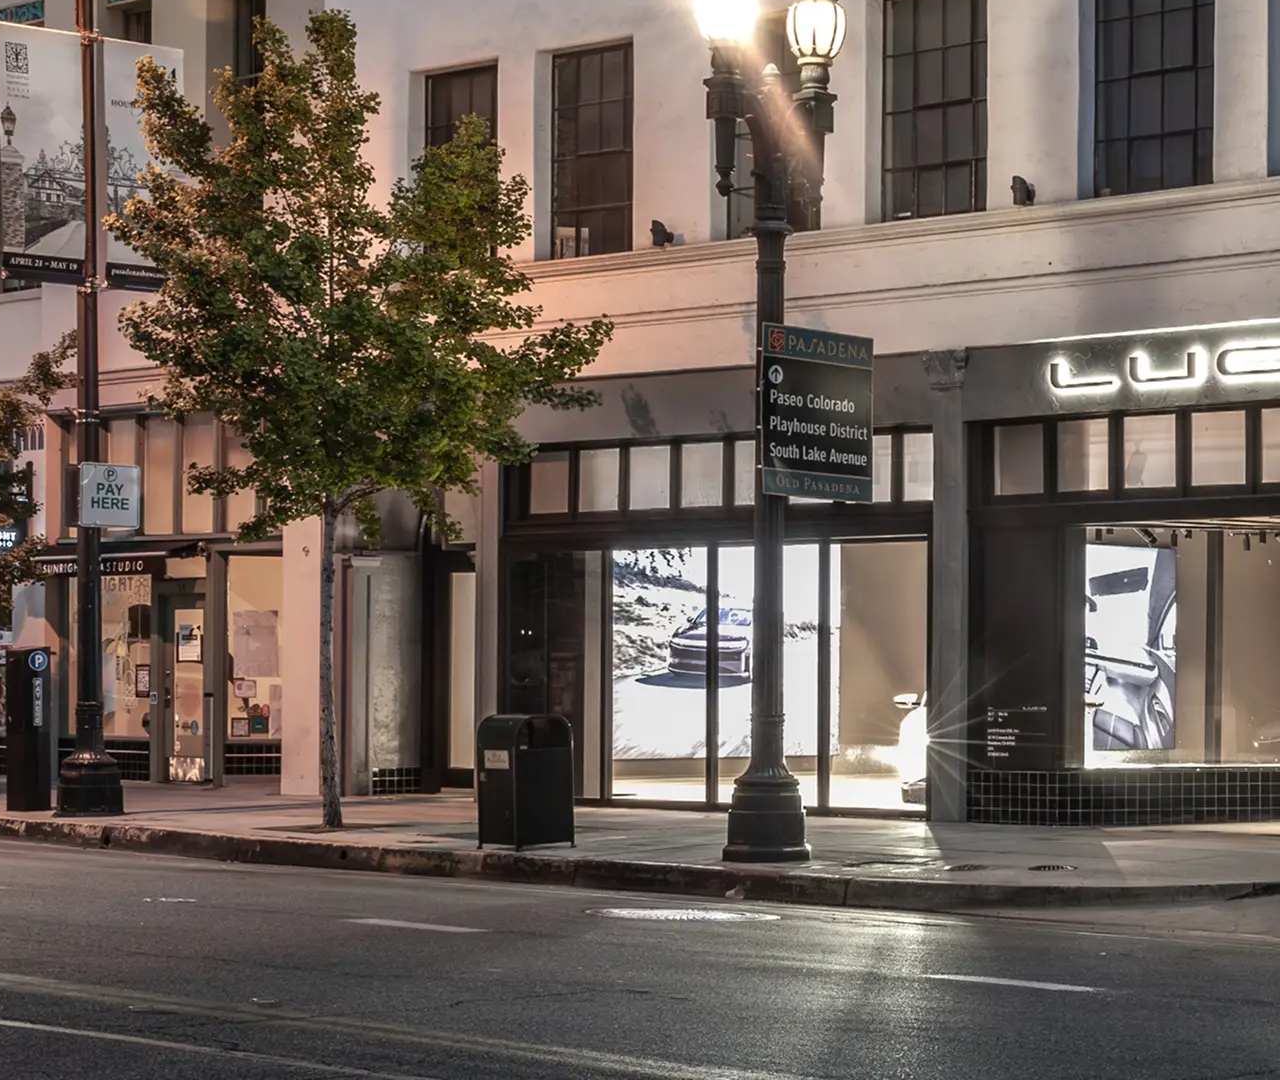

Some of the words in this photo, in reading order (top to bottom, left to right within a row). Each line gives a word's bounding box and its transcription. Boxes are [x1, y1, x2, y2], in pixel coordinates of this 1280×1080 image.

[10, 257, 33, 267] APRIL
[34, 258, 43, 267] 21
[51, 261, 67, 270] MAY
[69, 262, 78, 271] 19
[788, 334, 869, 361] PASADENA
[770, 388, 804, 407] Paseo
[807, 393, 855, 413] Colorado
[770, 416, 826, 436] Playhouse
[830, 422, 868, 440] District
[769, 441, 800, 459] South
[803, 446, 826, 462] Lake
[829, 448, 868, 466] Avenue
[96, 483, 124, 496] PAY
[91, 497, 129, 510] HERE
[42, 563, 78, 574] SUNRIGH
